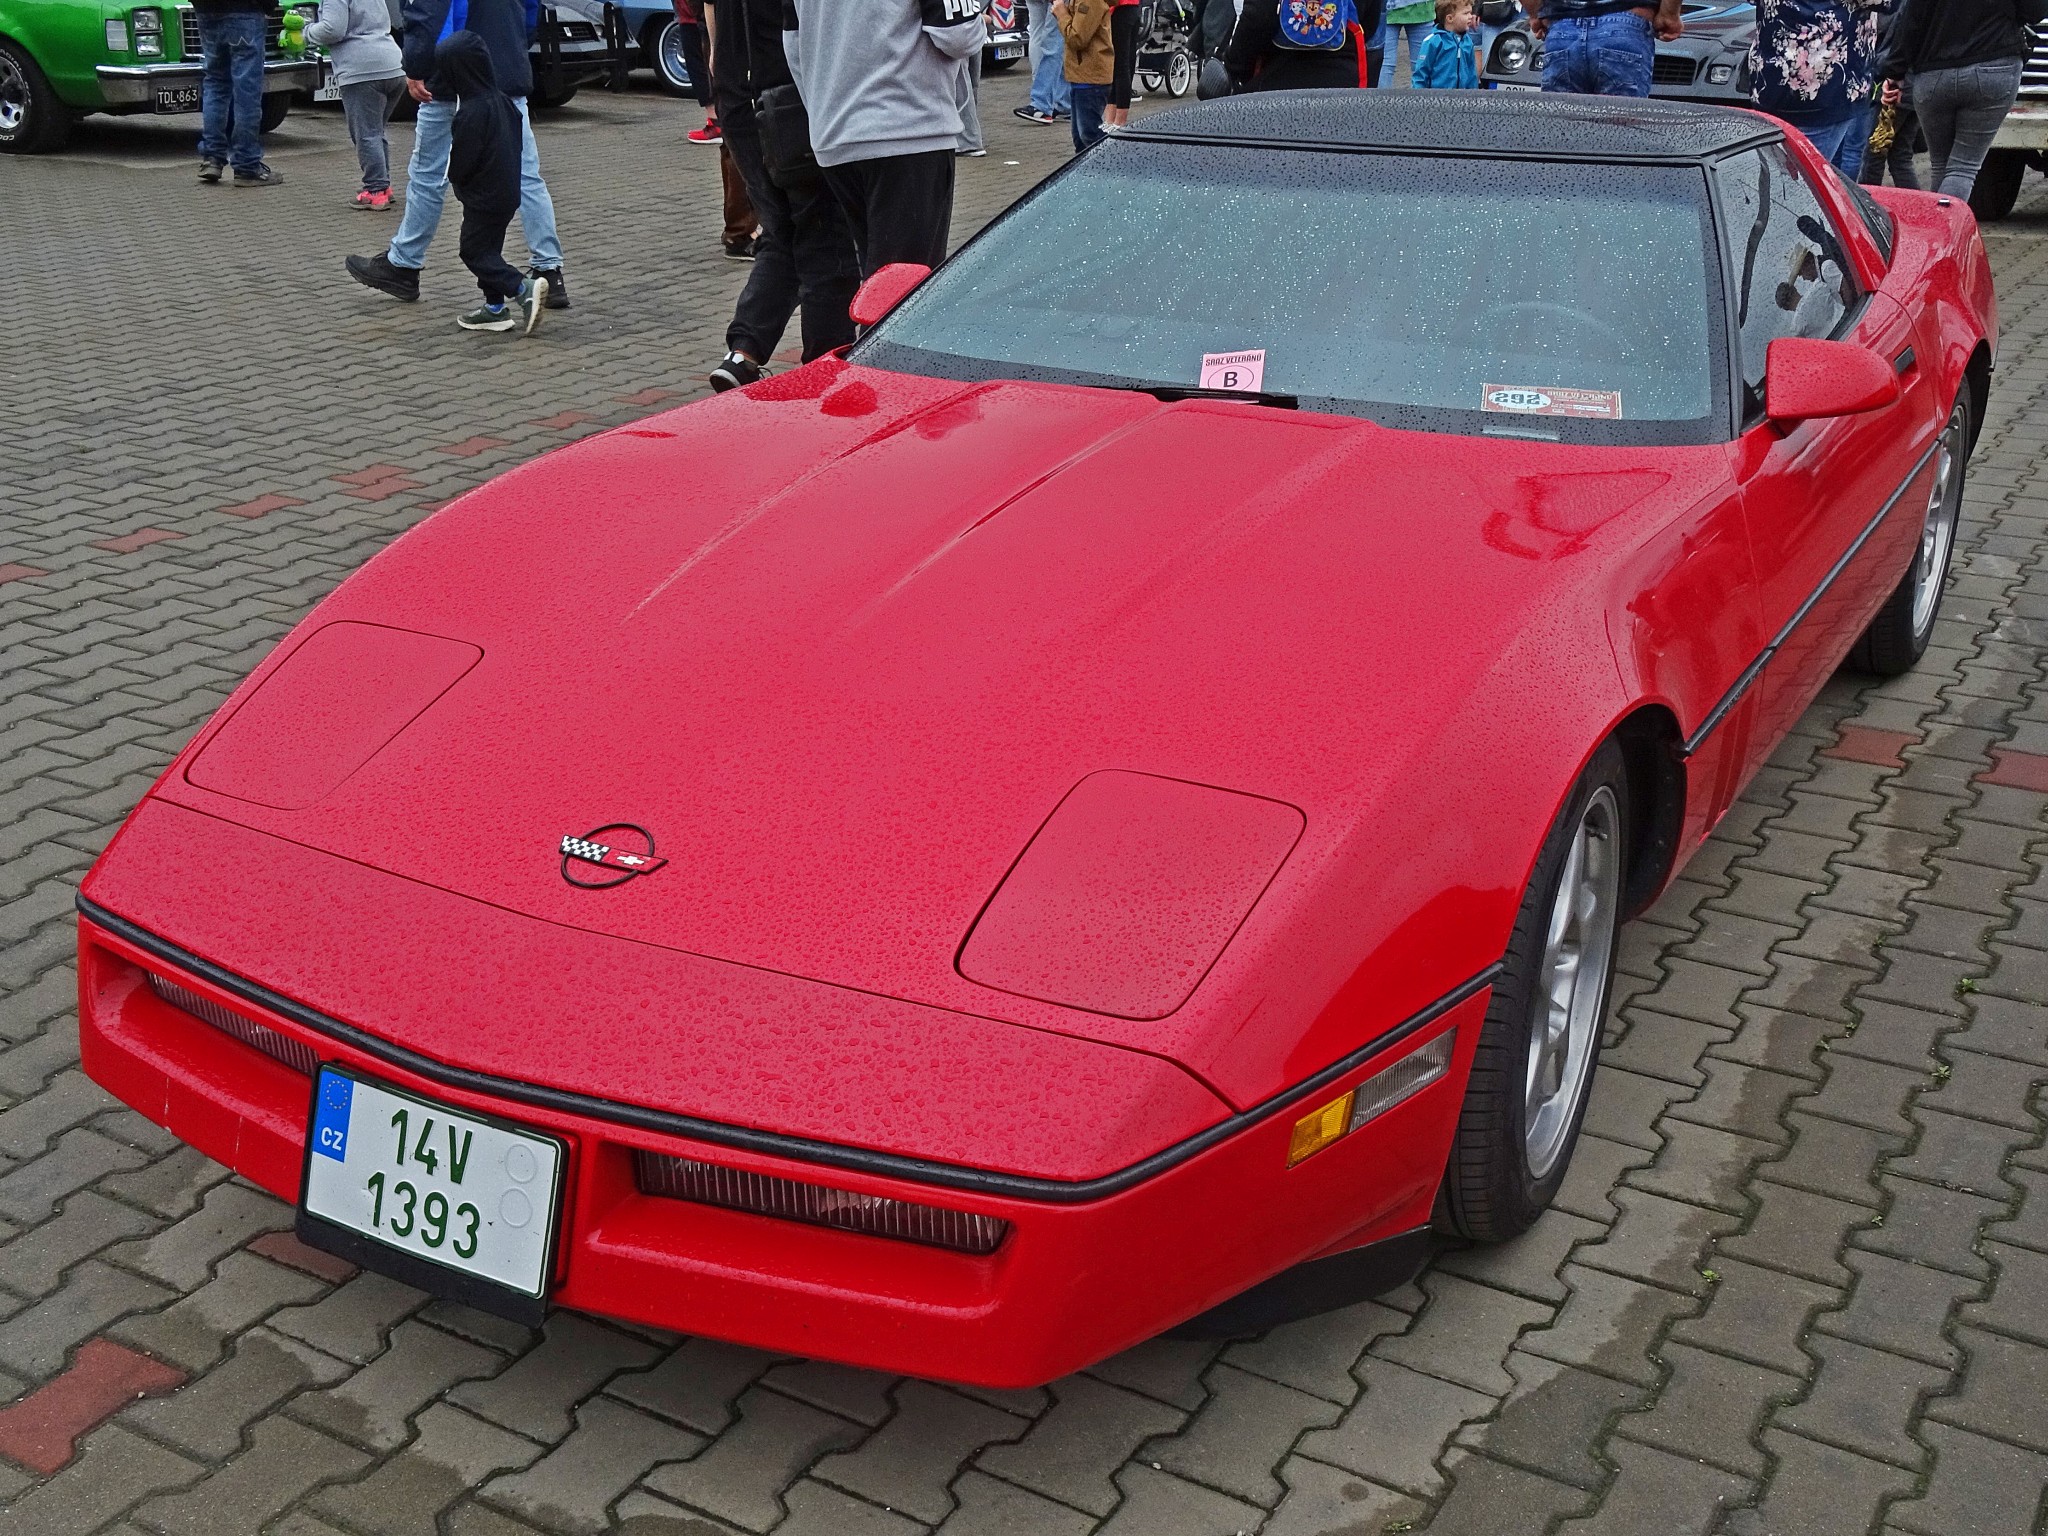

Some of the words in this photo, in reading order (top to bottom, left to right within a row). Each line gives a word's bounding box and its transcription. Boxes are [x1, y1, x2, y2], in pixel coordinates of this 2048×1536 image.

[1223, 371, 1238, 388] B
[1494, 392, 1541, 405] 292
[321, 1126, 343, 1151] CZ
[391, 1108, 473, 1185] 14V
[367, 1171, 481, 1259] 1393
